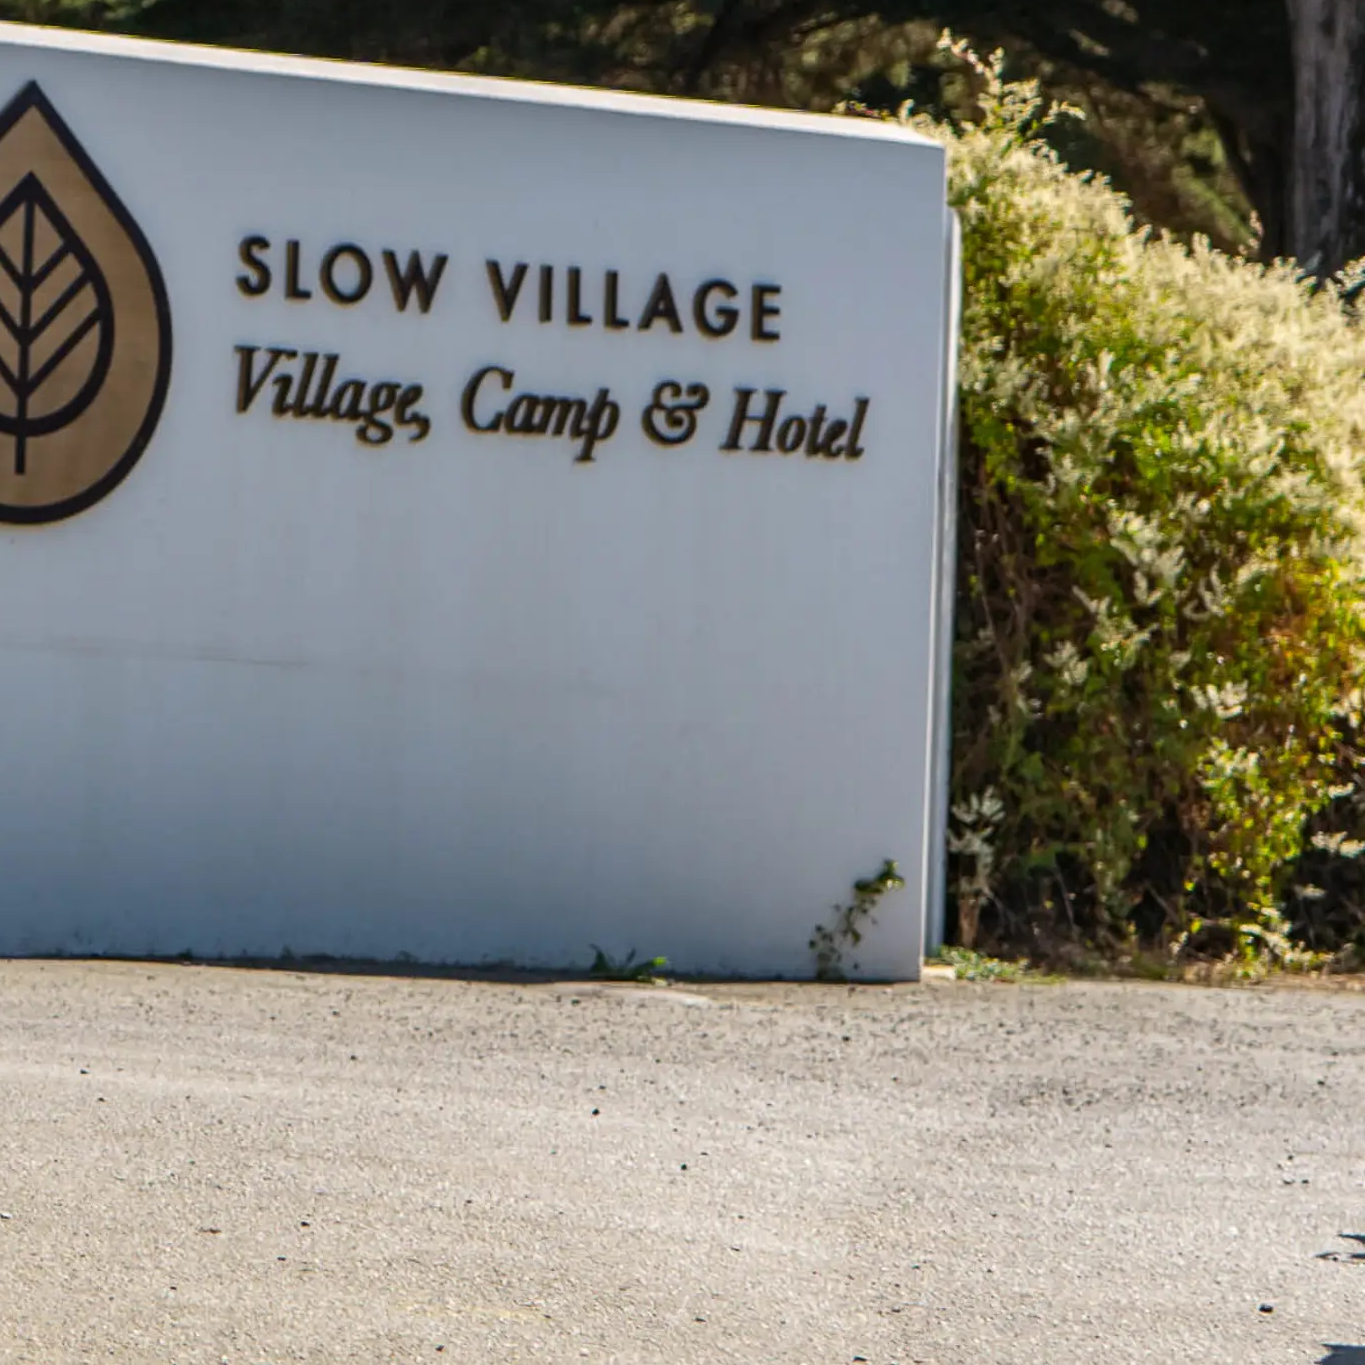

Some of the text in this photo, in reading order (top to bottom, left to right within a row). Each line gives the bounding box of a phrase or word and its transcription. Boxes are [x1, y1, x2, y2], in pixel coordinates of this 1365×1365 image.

[235, 234, 782, 343] SLOW VILLAGE
[233, 344, 870, 464] Village, Camp & Hotel
